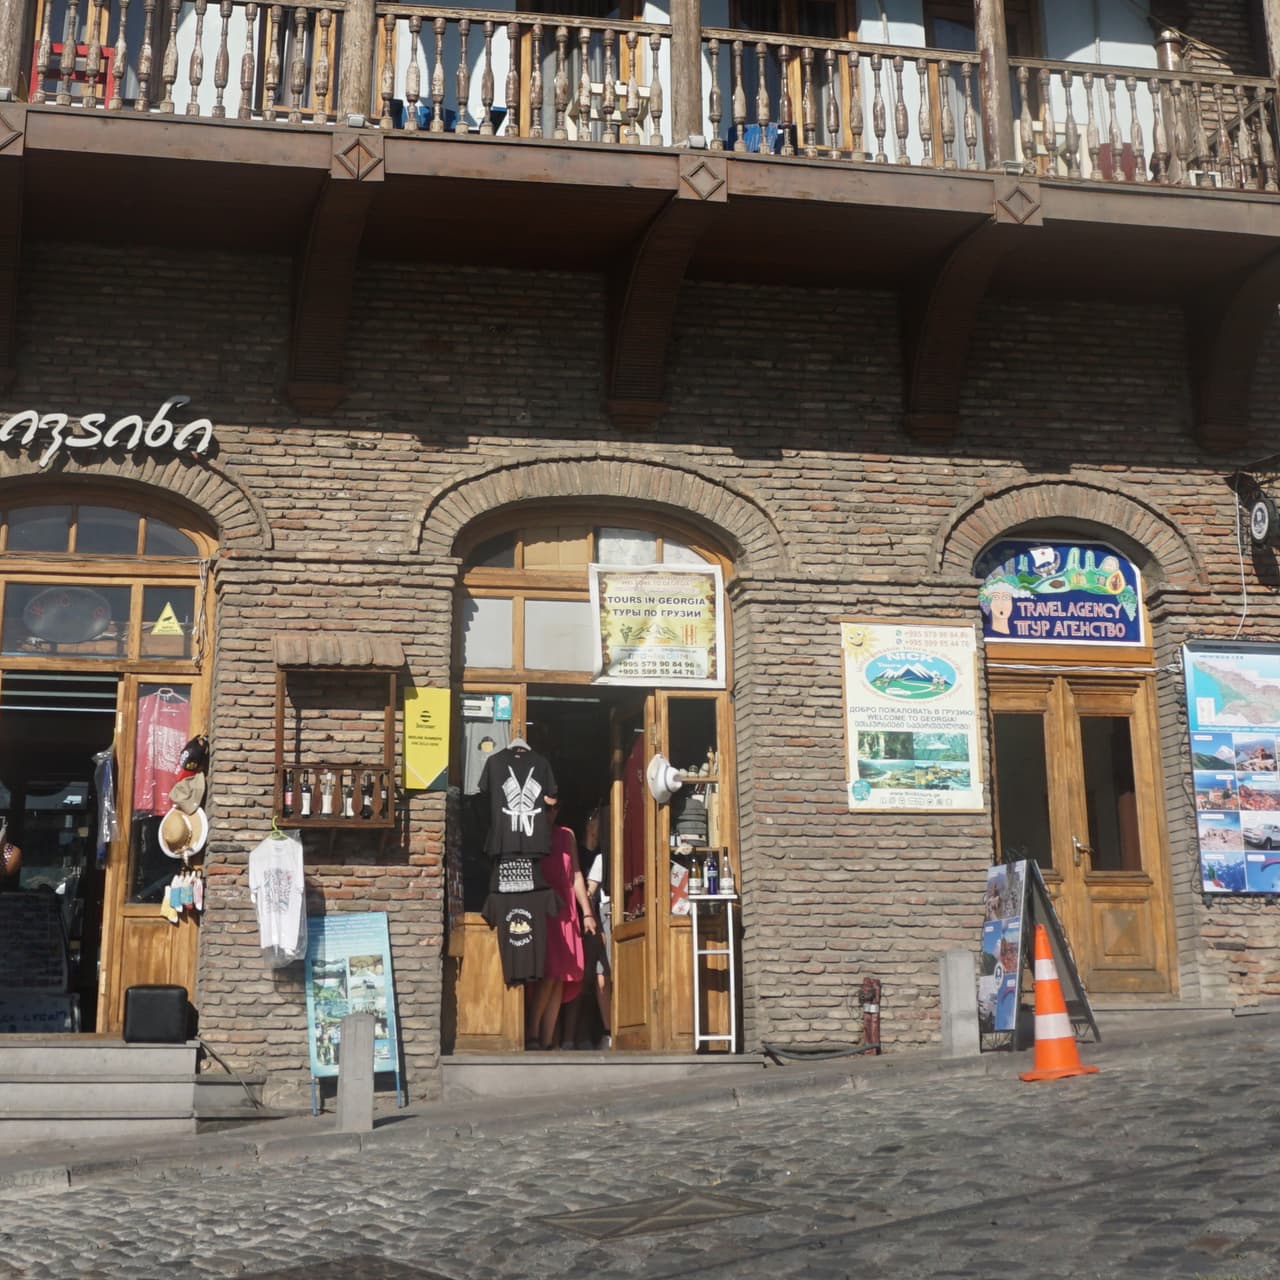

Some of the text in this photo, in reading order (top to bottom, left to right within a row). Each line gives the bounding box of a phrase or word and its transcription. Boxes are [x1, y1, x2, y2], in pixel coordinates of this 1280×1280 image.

[608, 596, 642, 604] TOURS
[658, 597, 706, 605] GEORGIA
[613, 608, 701, 618] ТУРЫ ПО ГРУЗИИ
[1017, 601, 1123, 619] TRAVEL AGENCY
[1053, 620, 1126, 638] АГЕНСТВО
